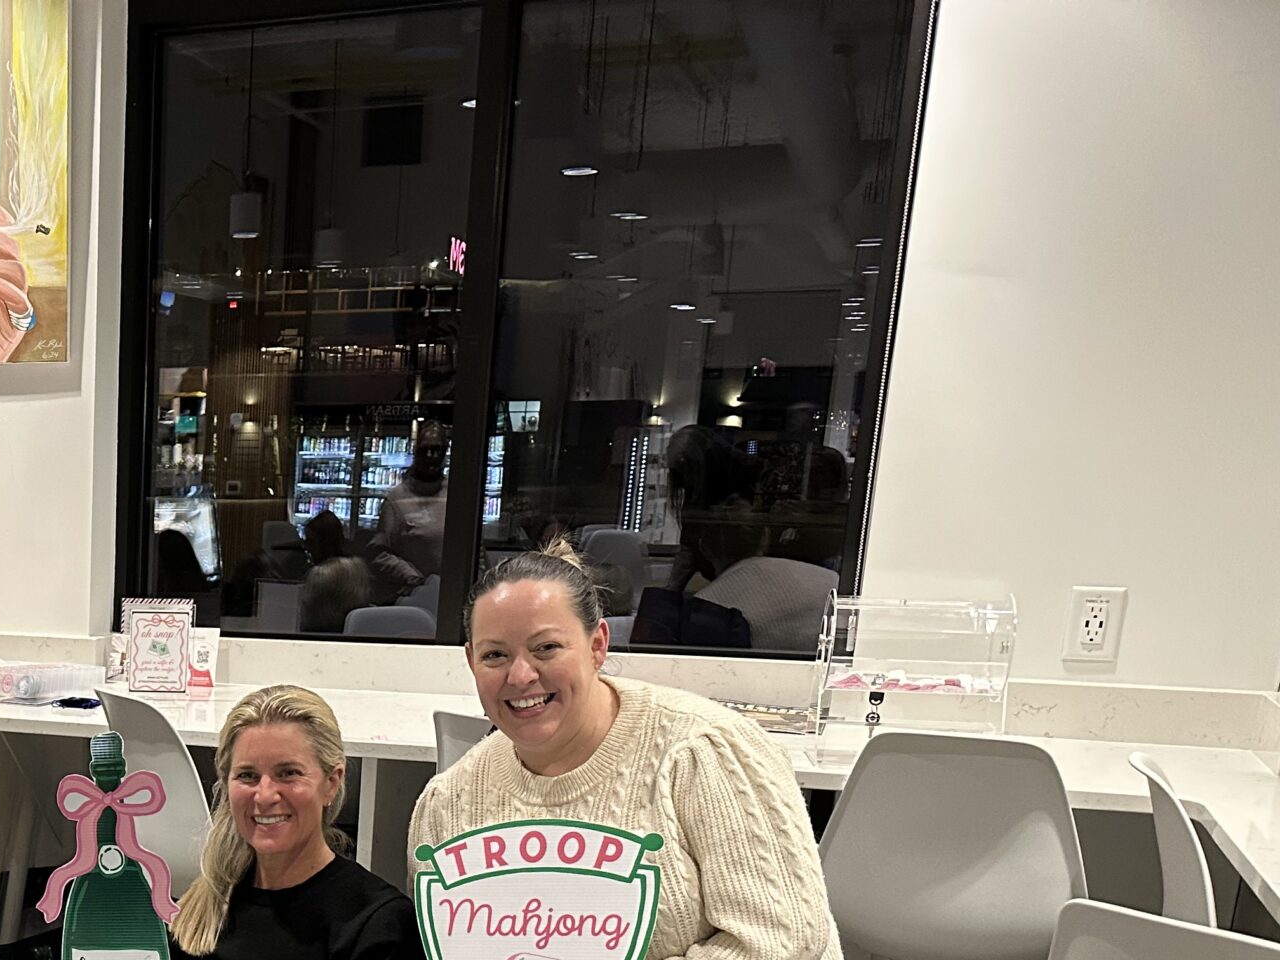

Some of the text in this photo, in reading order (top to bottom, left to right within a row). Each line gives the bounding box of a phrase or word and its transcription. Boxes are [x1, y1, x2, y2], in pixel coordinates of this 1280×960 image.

[141, 628, 152, 638] oh
[444, 830, 624, 877] TROOP
[439, 898, 630, 950] Mahjong
